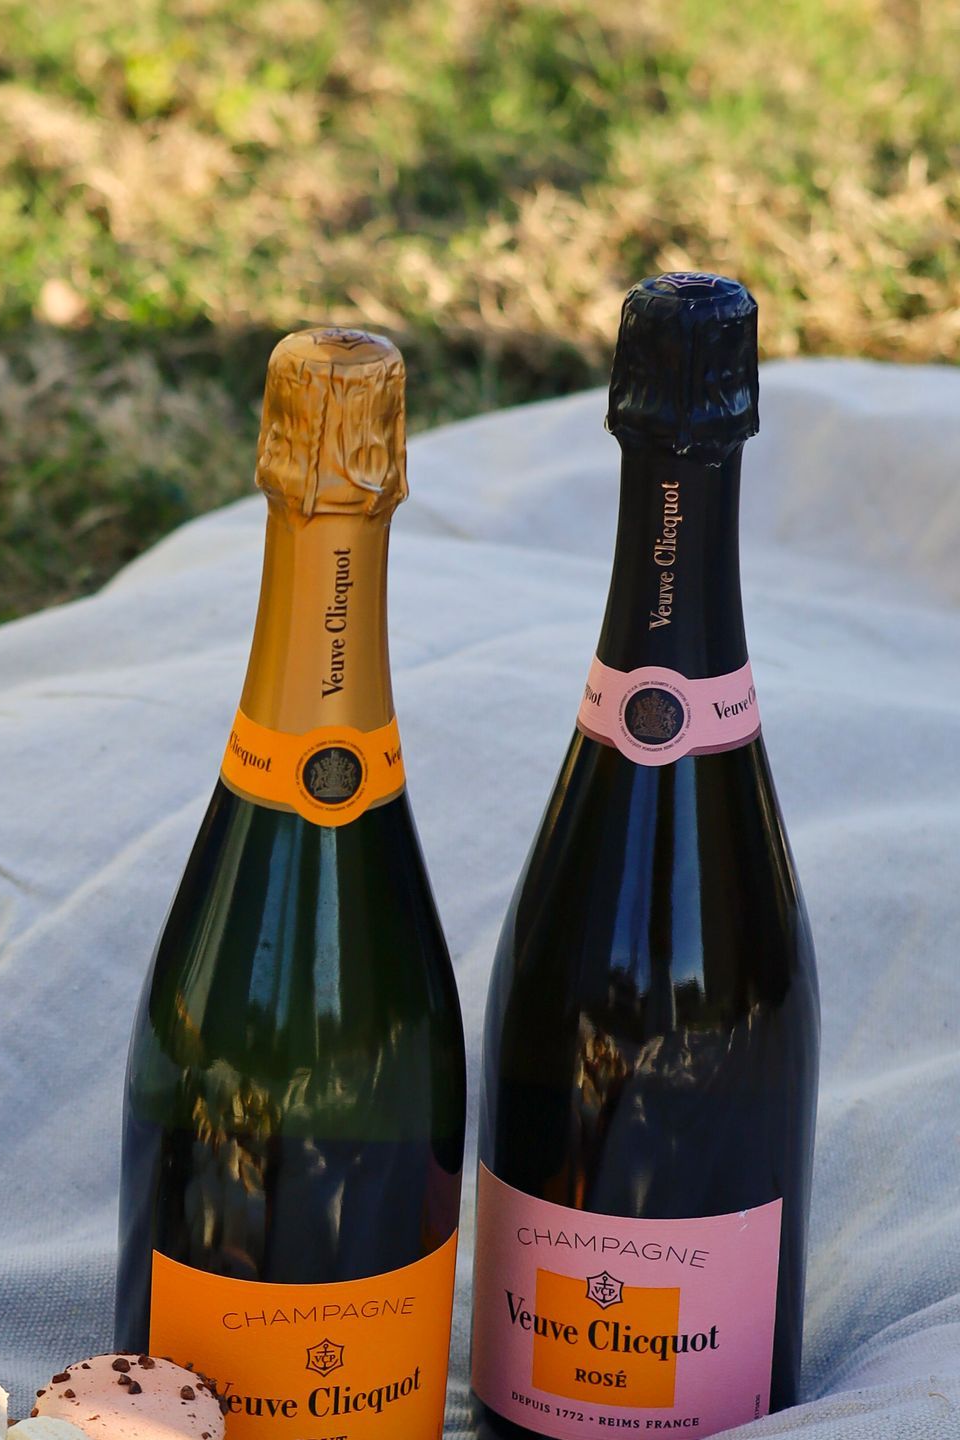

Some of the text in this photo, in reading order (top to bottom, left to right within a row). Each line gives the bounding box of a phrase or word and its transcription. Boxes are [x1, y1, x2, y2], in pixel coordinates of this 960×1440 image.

[648, 480, 683, 631] Veuve Clicquot
[321, 547, 354, 699] Veuve Clicquot
[711, 699, 749, 720] Veuve
[516, 1227, 710, 1268] CHAMPAGNE
[221, 1296, 416, 1330] CHAMPAGNE
[504, 1289, 720, 1361] Veuve Clicquot
[307, 1366, 421, 1418] Clicquot
[574, 1367, 627, 1388] ROSÉ
[511, 1391, 700, 1429] DEPUIS 1772 REIMS FRANCE
